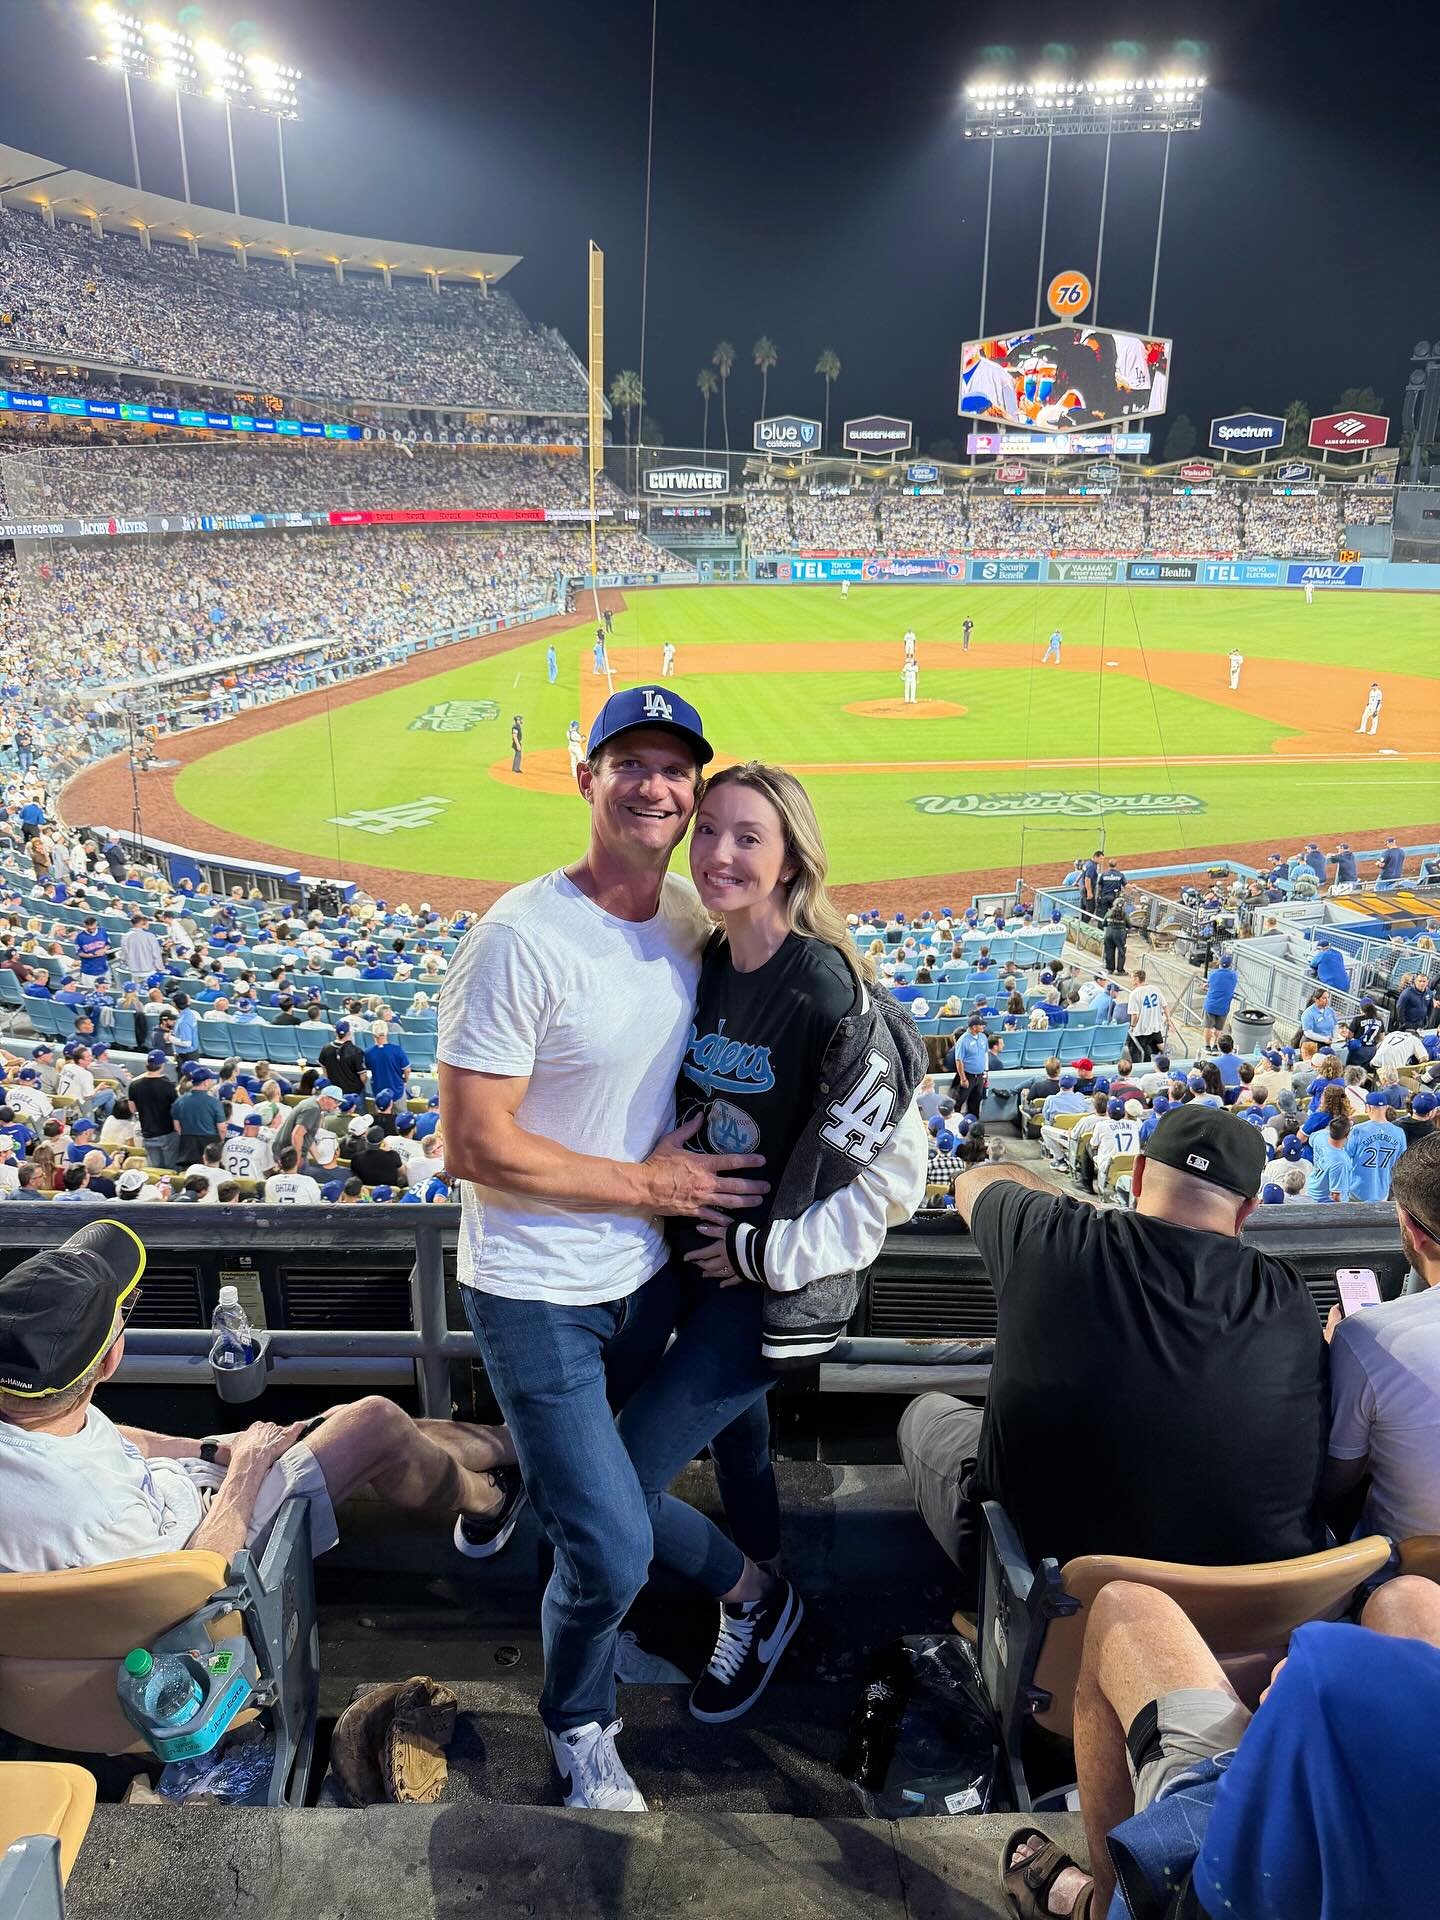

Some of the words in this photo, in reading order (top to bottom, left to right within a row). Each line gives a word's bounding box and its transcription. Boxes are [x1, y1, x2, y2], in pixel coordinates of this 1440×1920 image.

[1056, 284, 1083, 304] 76
[761, 423, 797, 440] blue
[1218, 425, 1273, 440] Spectrum
[766, 439, 801, 448] california
[649, 472, 722, 489] CUTWATER
[5, 525, 17, 535] TO
[17, 524, 32, 535] BAT
[33, 523, 48, 534] FOR
[48, 523, 63, 534] YOU
[79, 519, 109, 536] JACOBY
[115, 518, 148, 533] MEYERS
[1340, 550, 1361, 563] 0:21
[793, 562, 827, 578] TEL
[830, 568, 861, 576] ELECTRON
[1000, 563, 1029, 573] Security
[1135, 567, 1155, 576] UCLA
[1160, 567, 1191, 578] Health
[1207, 566, 1240, 581] TEL
[1302, 567, 1333, 578] ANA
[642, 690, 673, 720] LA
[916, 792, 1071, 815] World
[1059, 792, 1200, 816] Series
[1143, 993, 1158, 1009] 42
[683, 1019, 775, 1097] dgers
[819, 1048, 897, 1166] LA
[1114, 1133, 1133, 1152] 17
[1362, 1133, 1391, 1147] GUERRERO
[229, 1156, 250, 1176] 22
[1362, 1147, 1396, 1169] 27
[211, 1710, 229, 1734] Uber
[227, 1684, 244, 1708] Eats
